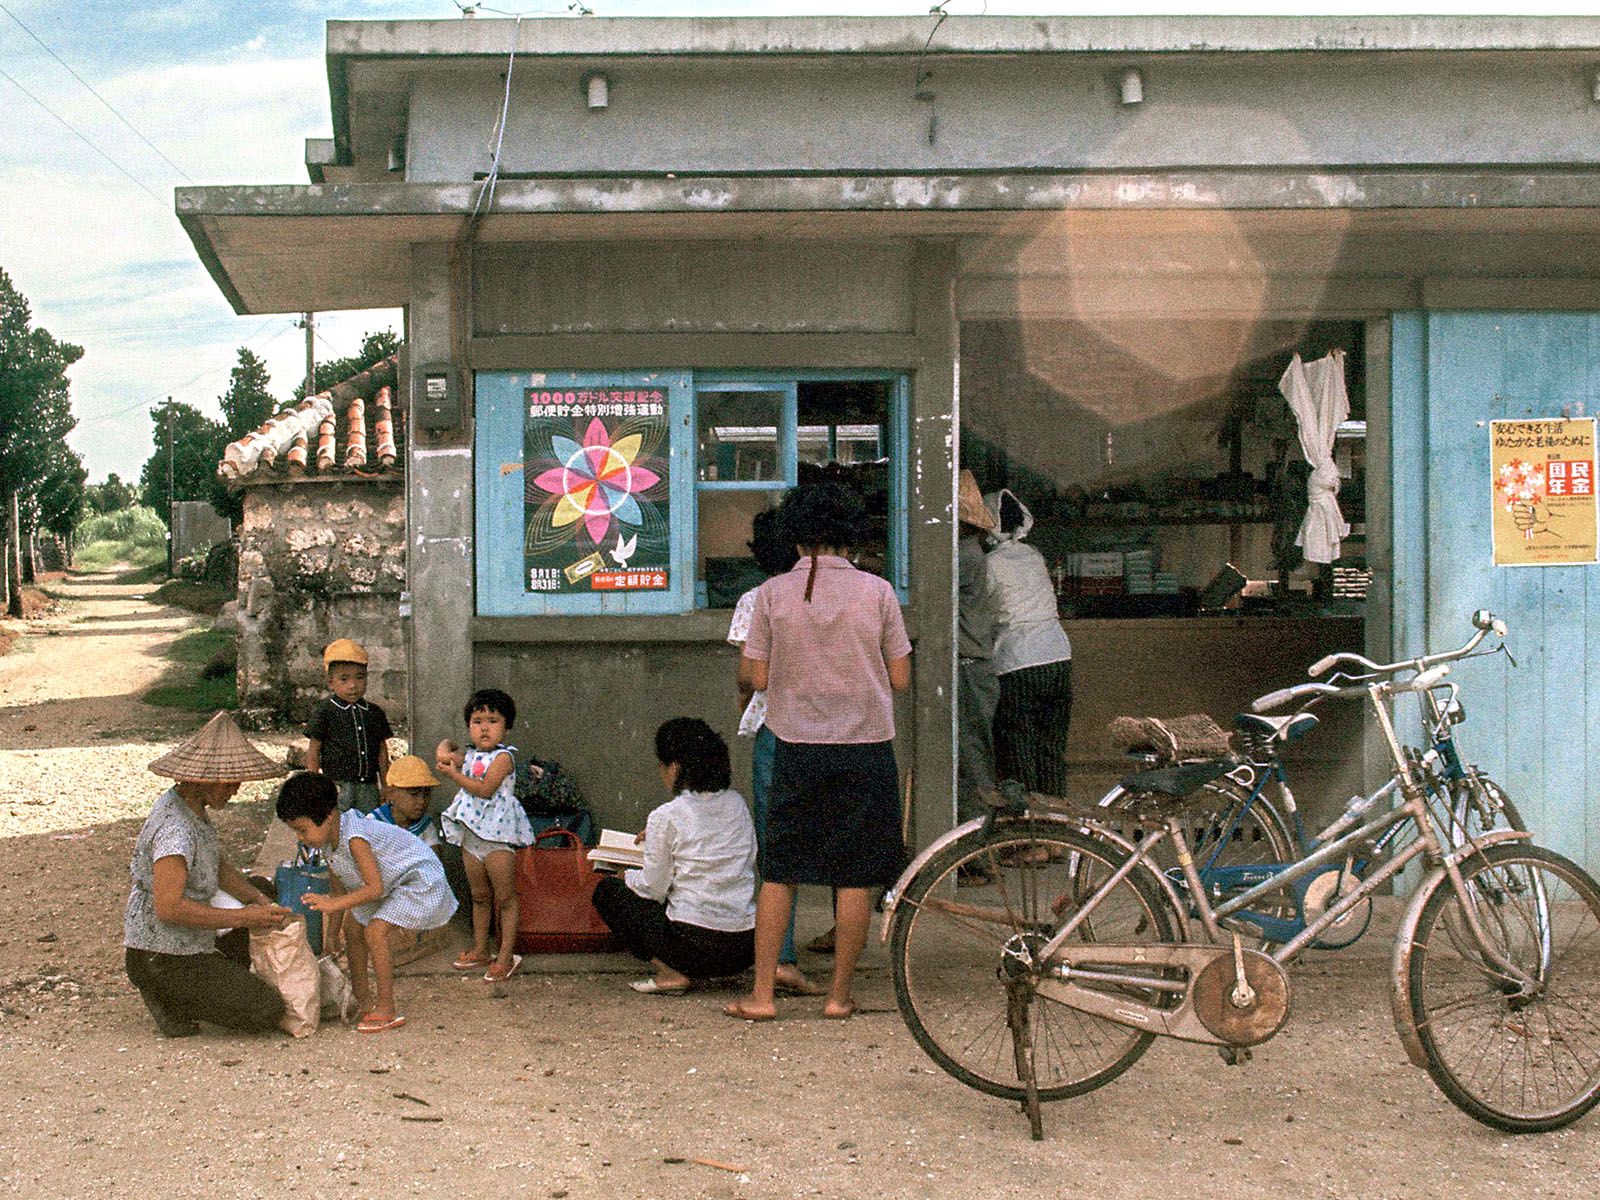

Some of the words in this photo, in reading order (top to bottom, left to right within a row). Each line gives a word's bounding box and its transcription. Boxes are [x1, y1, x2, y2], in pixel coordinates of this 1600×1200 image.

[530, 391, 663, 404] 1000万ドル突破記念
[530, 404, 663, 417] 郵便貯金特別増強運動
[1495, 422, 1563, 434] 安心できる生活
[1495, 436, 1591, 448] ゆたかな老後のために
[614, 574, 664, 587] 定額貯金
